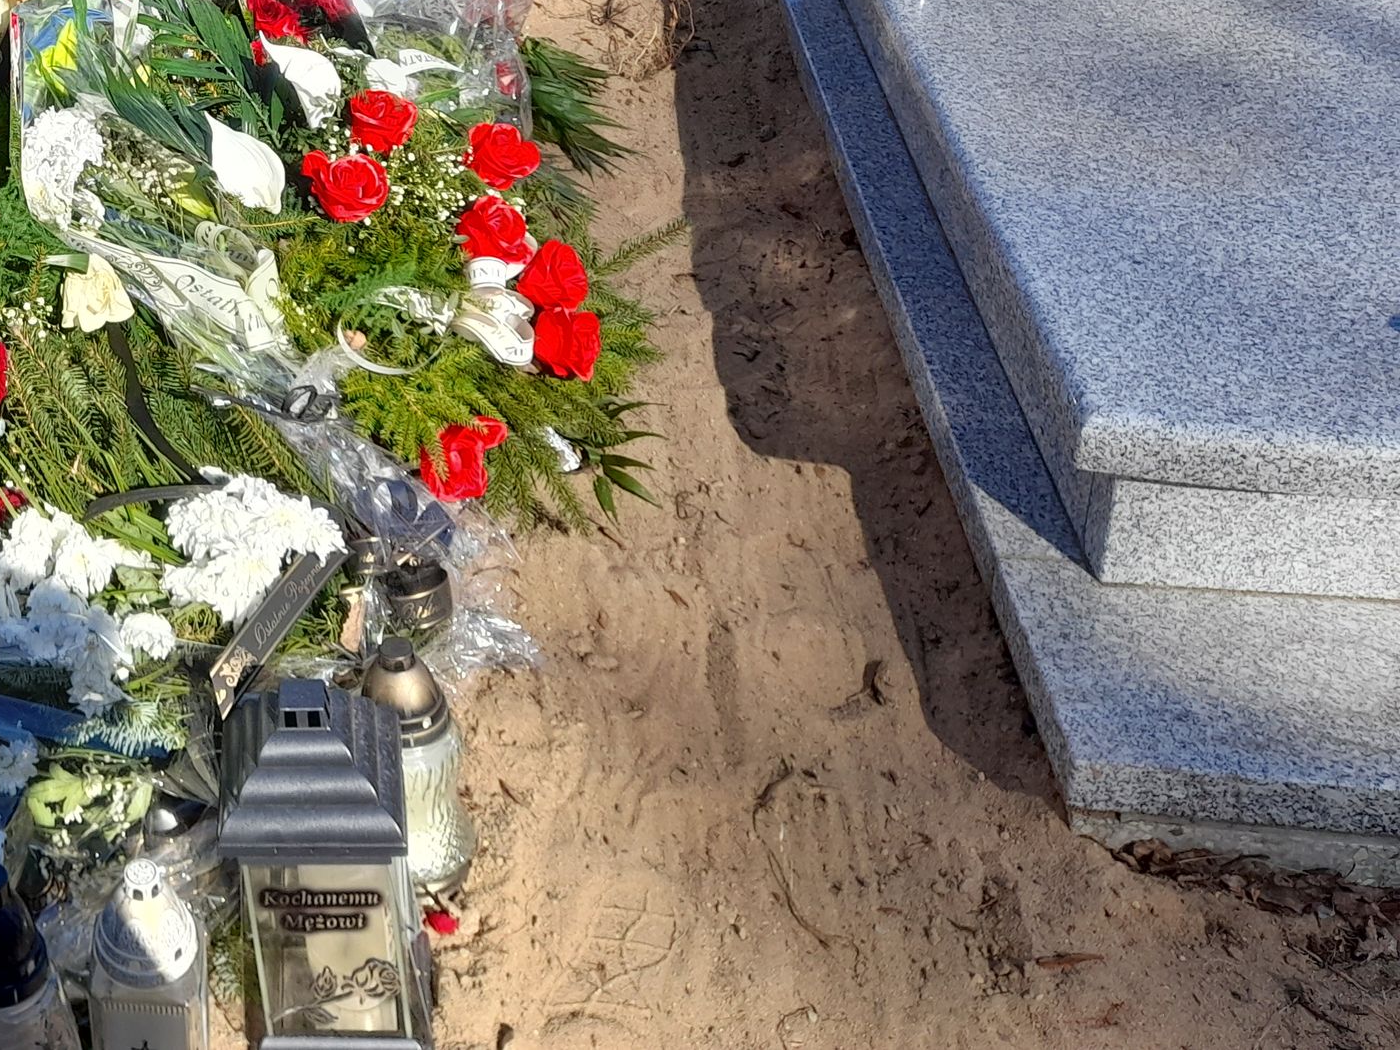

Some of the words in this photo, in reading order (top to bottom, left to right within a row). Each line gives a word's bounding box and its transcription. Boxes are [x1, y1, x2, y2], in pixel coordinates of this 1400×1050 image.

[253, 602, 292, 650] Ostatnie
[263, 891, 380, 906] Kochanemu
[284, 913, 365, 932] Mężowi
